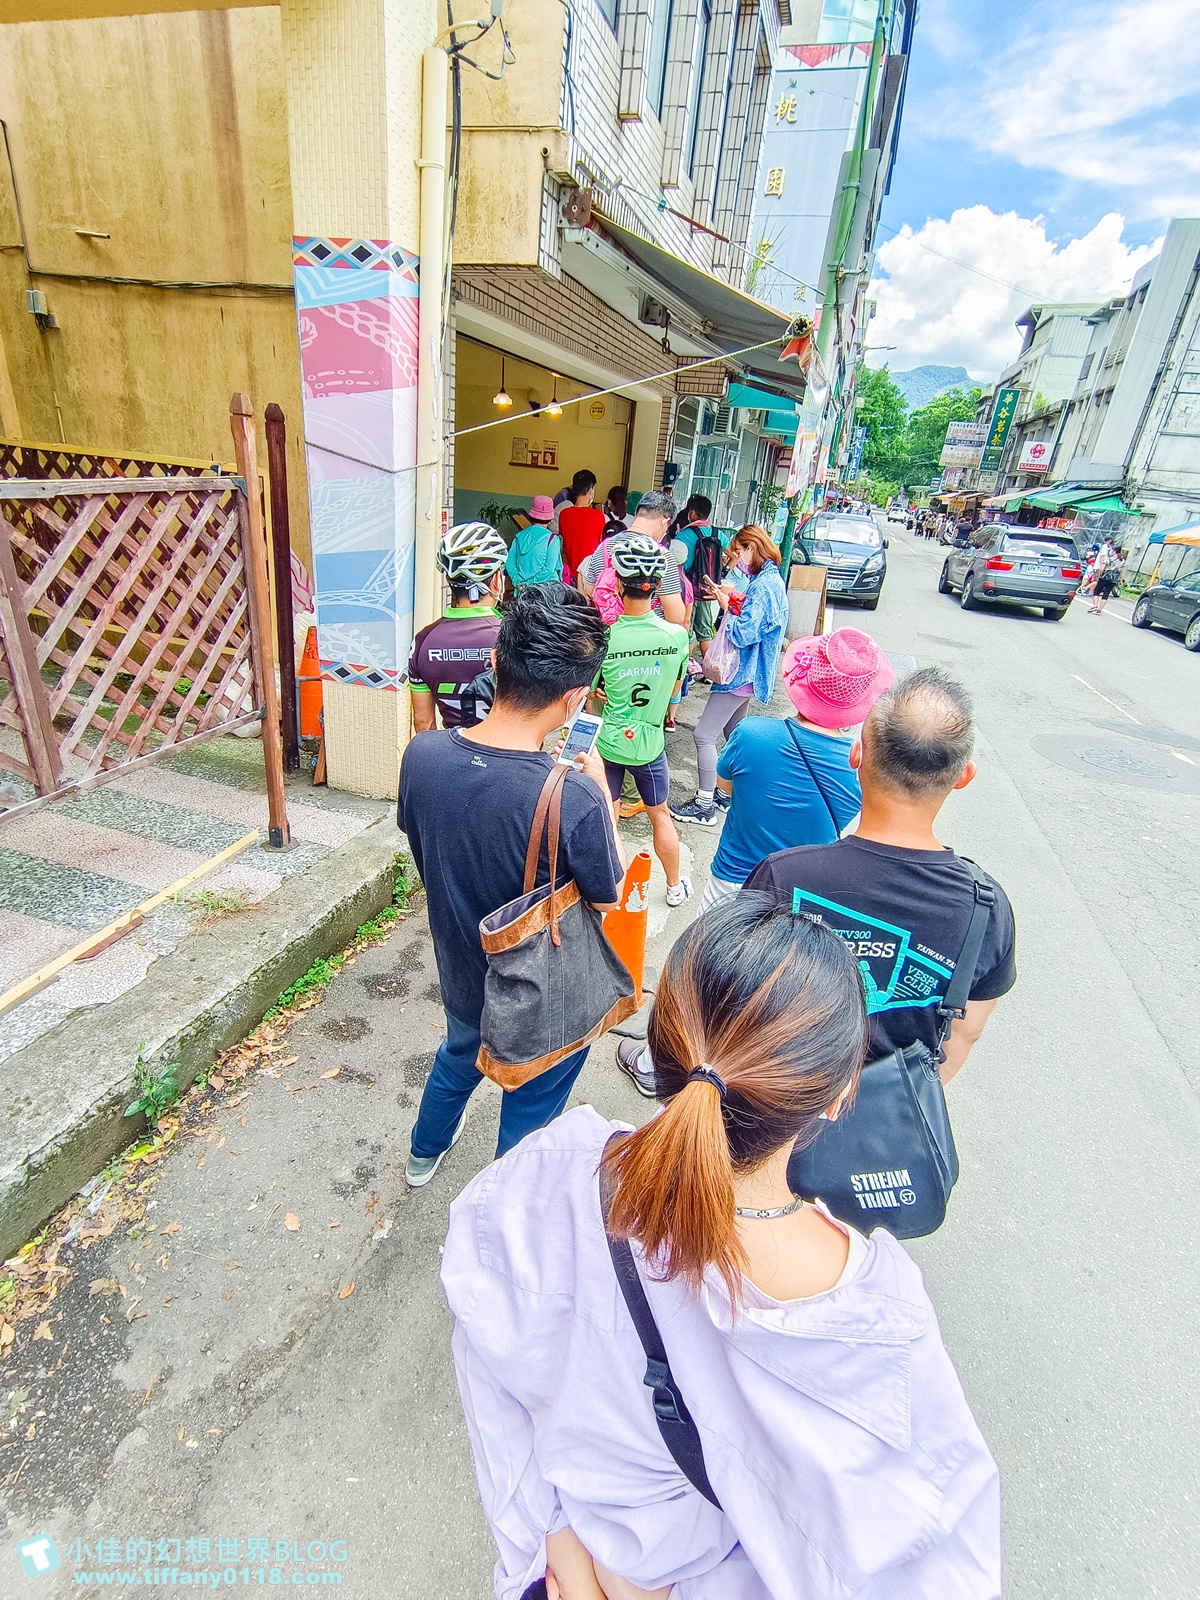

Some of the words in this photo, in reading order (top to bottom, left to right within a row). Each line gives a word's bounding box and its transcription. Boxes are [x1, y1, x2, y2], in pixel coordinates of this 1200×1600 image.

[990, 392, 1014, 446] 華谷茗茶
[604, 646, 678, 661] annondale
[618, 666, 661, 678] GARMIN
[903, 975, 931, 996] CLUB
[907, 964, 939, 989] VESPA
[850, 1169, 912, 1192] STREAM
[855, 1190, 900, 1209] TRAIL
